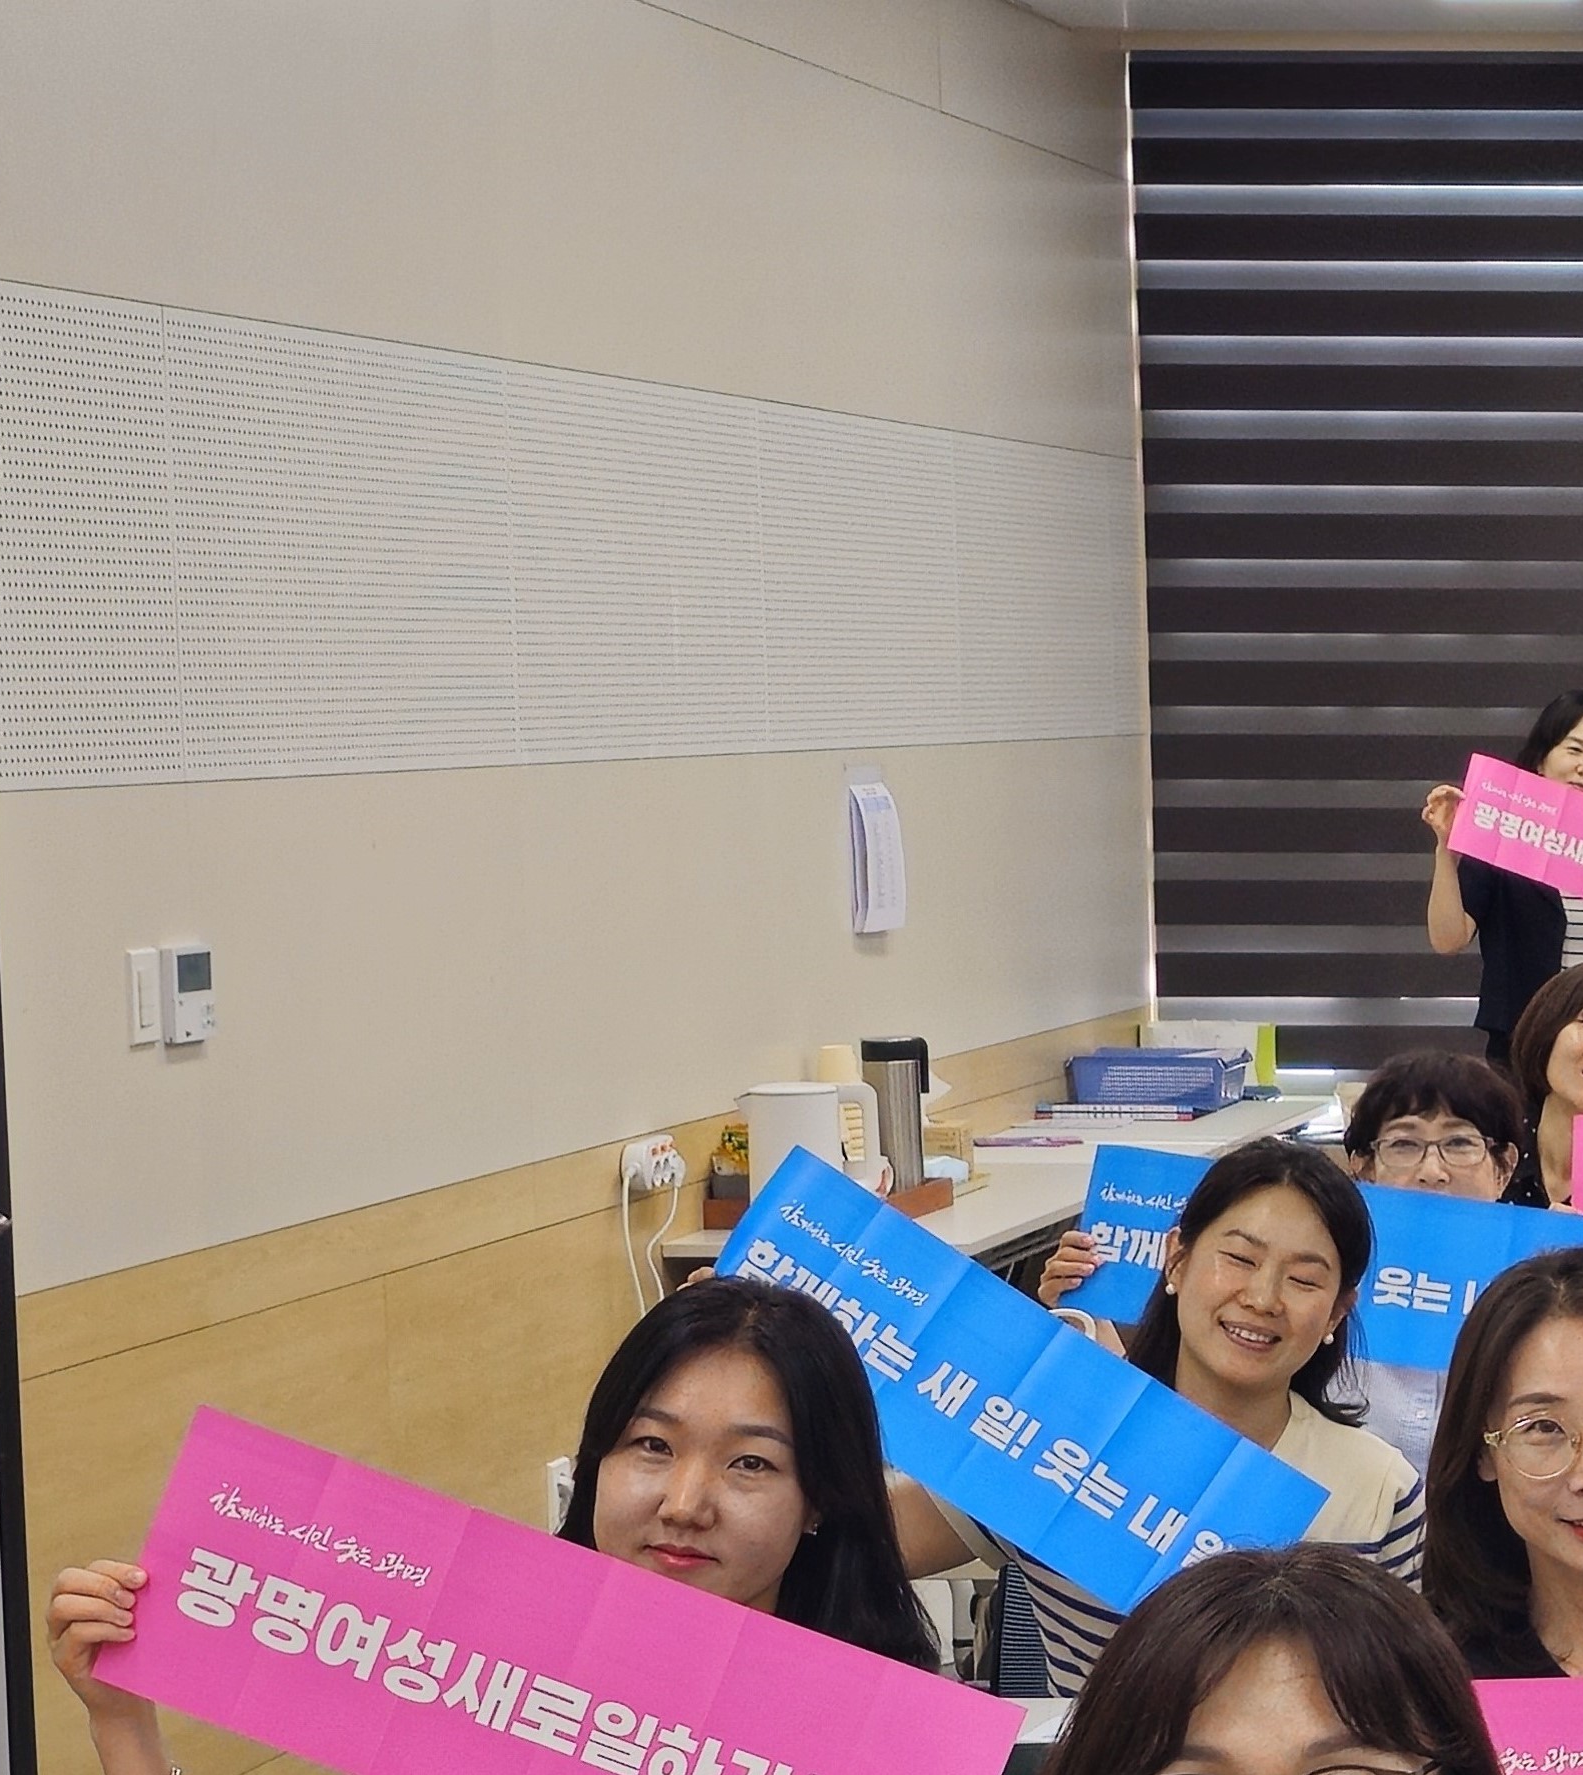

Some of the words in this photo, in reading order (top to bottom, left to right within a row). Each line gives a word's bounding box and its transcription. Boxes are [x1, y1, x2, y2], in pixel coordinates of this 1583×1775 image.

[917, 1361, 977, 1417] 새
[969, 1396, 1041, 1459] 일!
[1033, 1438, 1127, 1518] 웃는
[1127, 1494, 1188, 1555] 내
